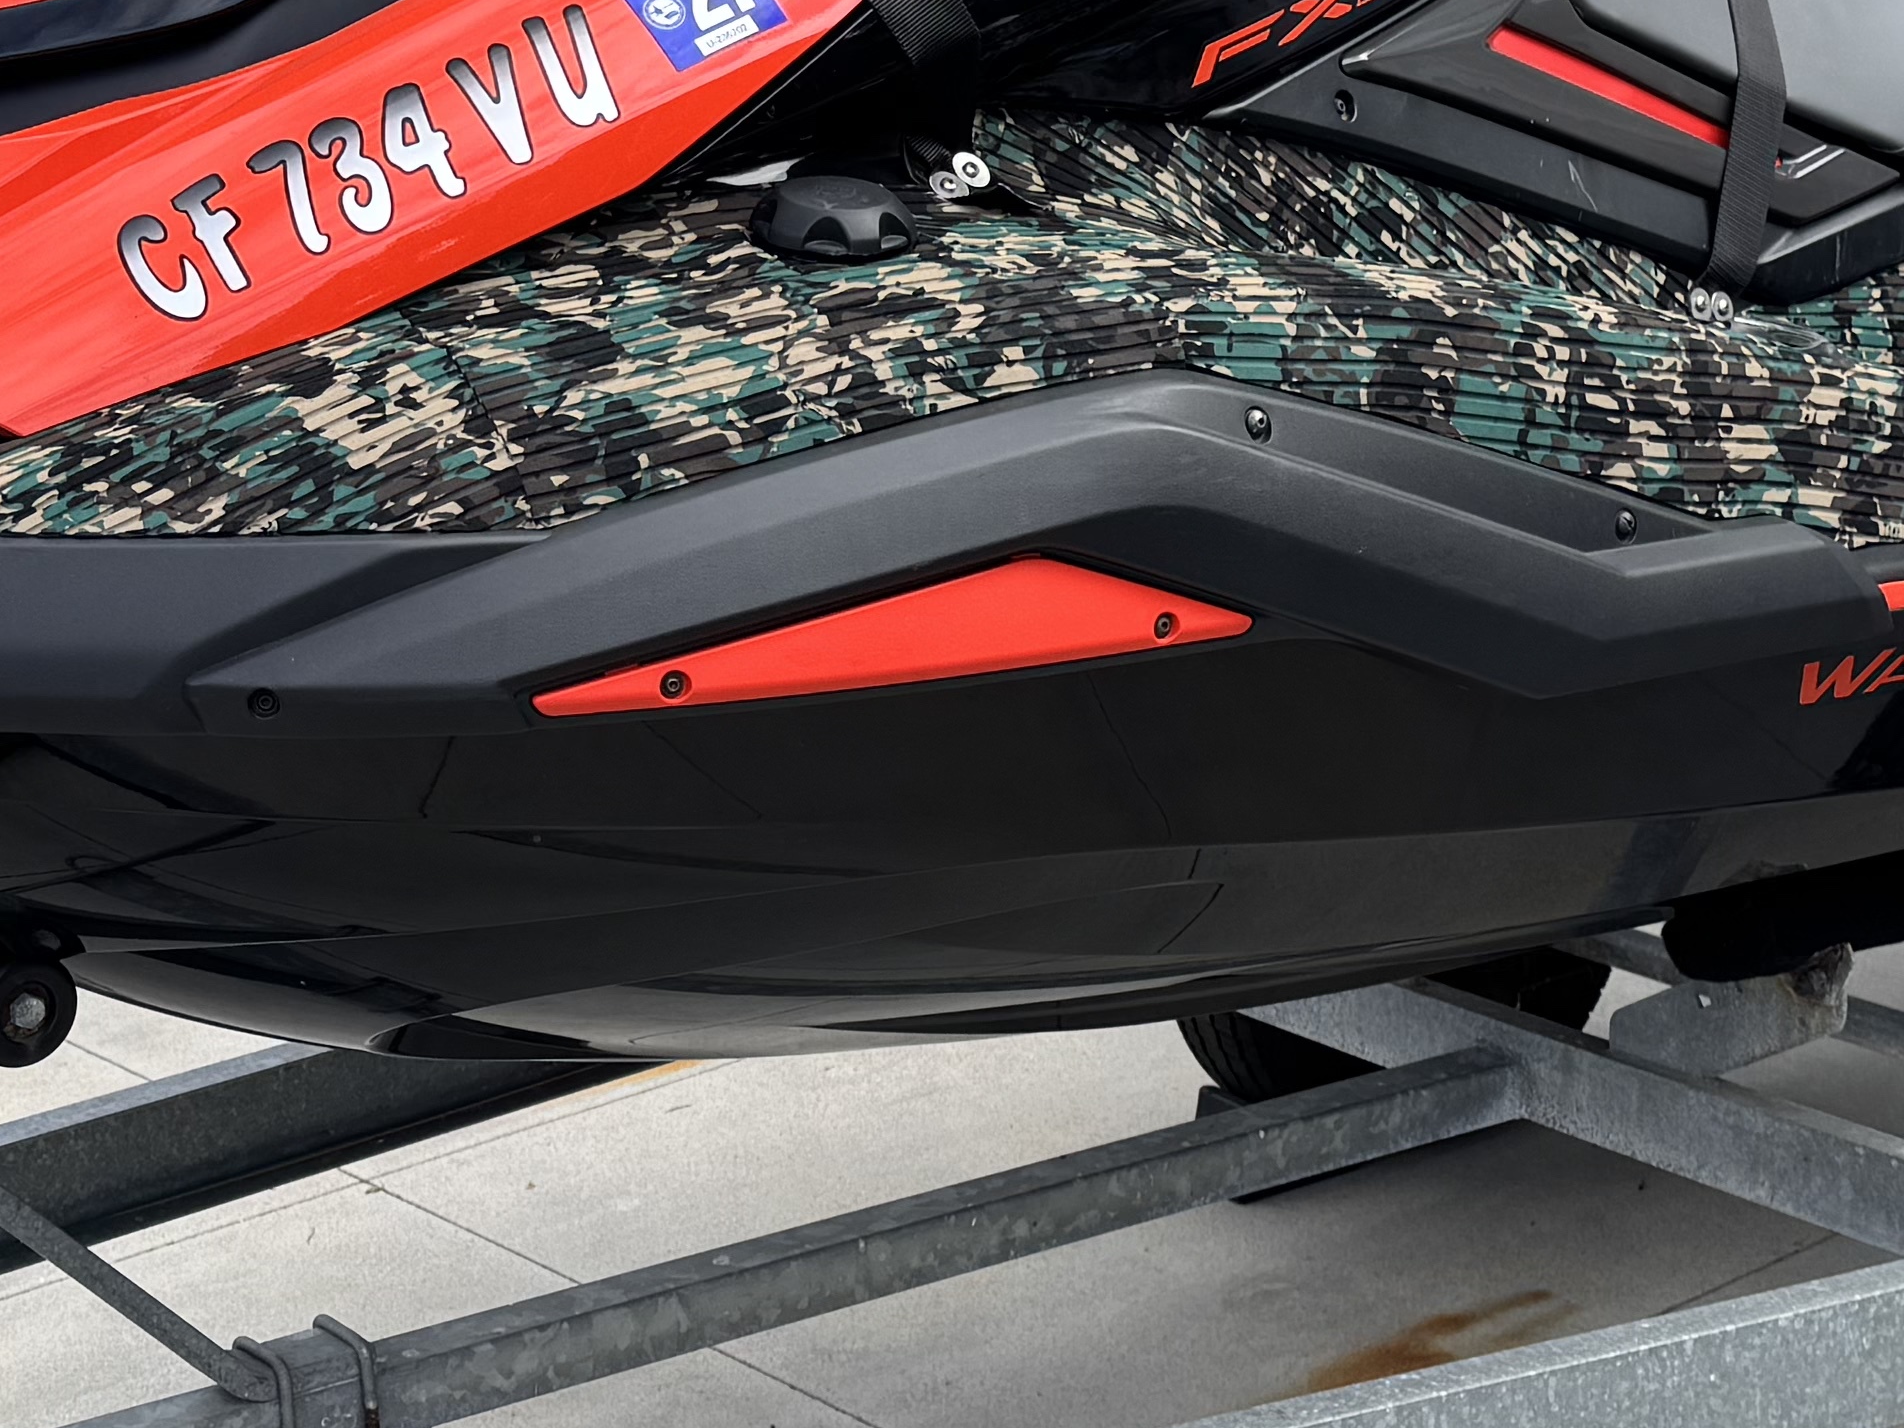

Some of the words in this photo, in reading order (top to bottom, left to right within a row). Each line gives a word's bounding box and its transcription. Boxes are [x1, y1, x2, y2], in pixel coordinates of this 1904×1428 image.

[117, 173, 252, 322] CF
[246, 82, 467, 255] 734
[445, 4, 621, 165] VU
